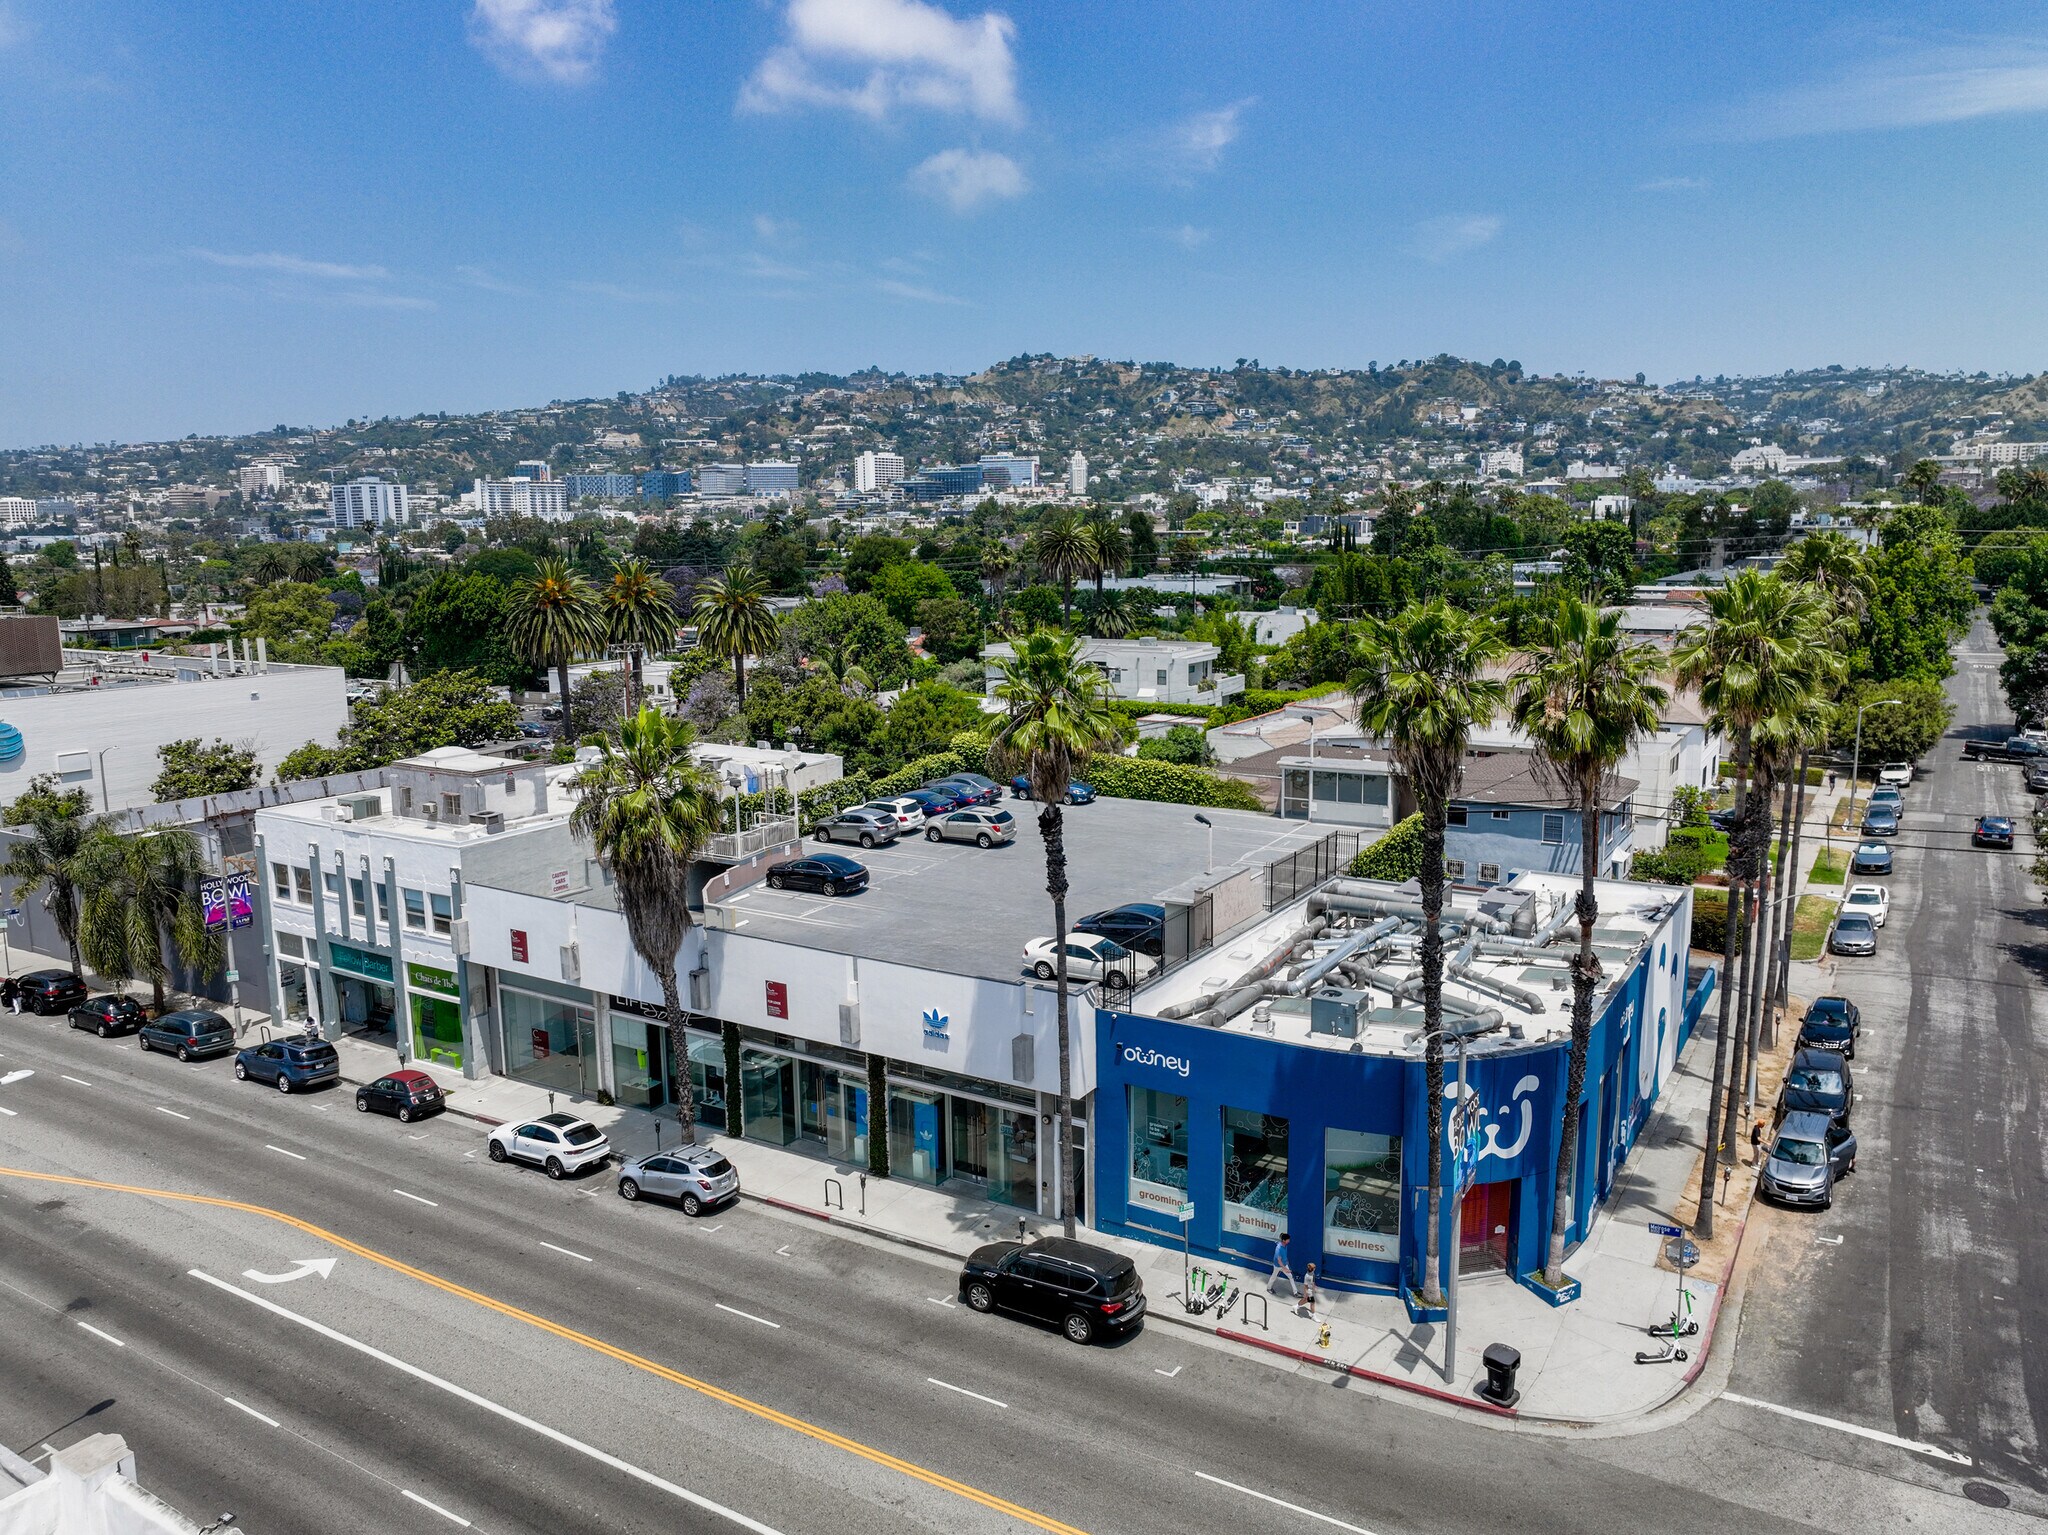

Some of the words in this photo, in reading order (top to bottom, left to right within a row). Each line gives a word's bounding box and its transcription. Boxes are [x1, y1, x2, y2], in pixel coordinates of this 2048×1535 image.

[1976, 763, 2009, 773] STP
[201, 882, 252, 906] BOWL
[364, 957, 389, 973] Barber
[433, 976, 442, 986] de
[923, 1029, 950, 1040] adidas
[1123, 1046, 1190, 1077] owney
[1238, 1213, 1277, 1233] bathing
[1650, 1223, 1671, 1233] Melrose
[1337, 1238, 1386, 1252] wellness
